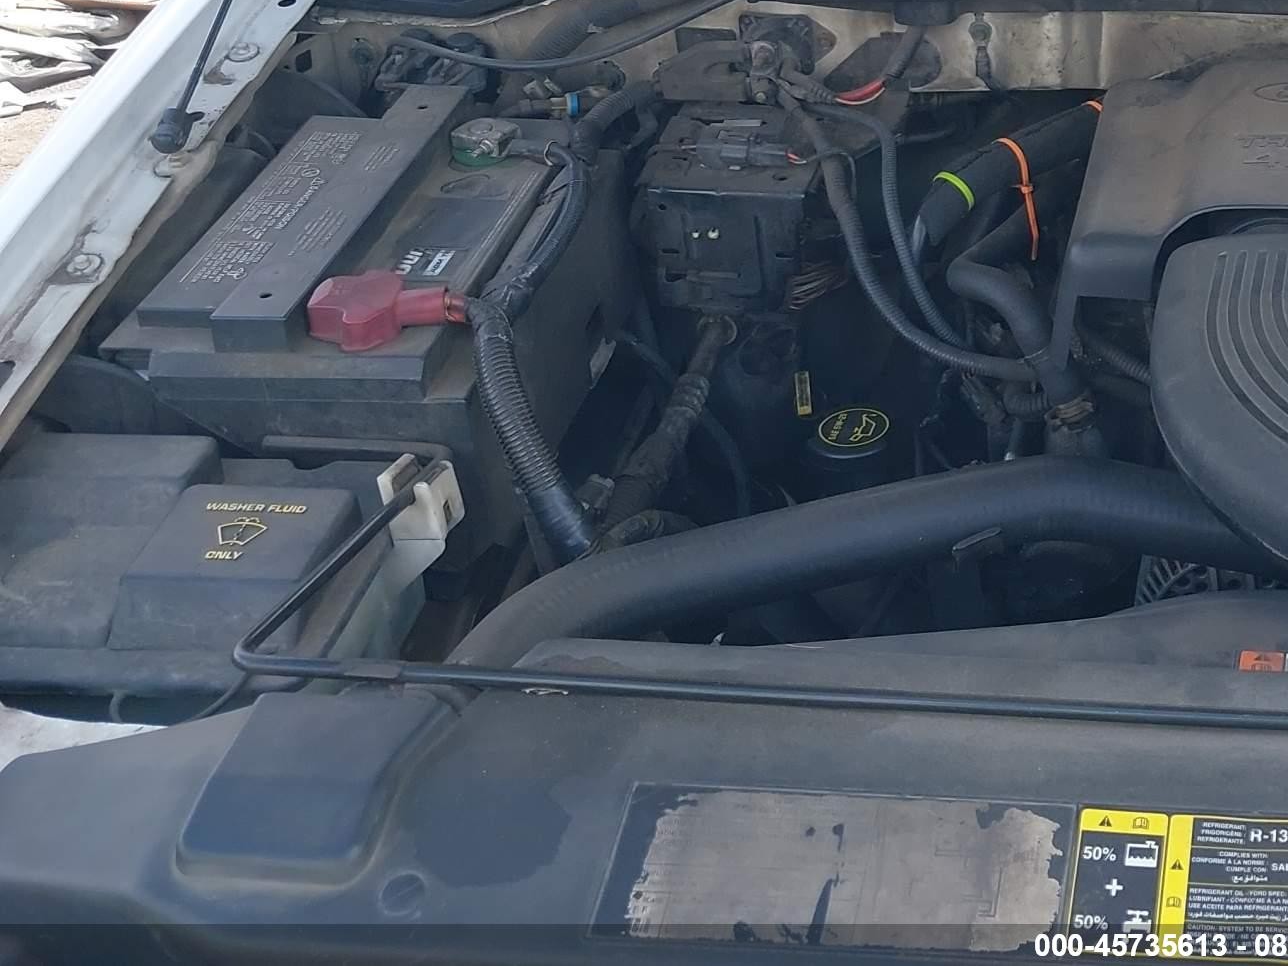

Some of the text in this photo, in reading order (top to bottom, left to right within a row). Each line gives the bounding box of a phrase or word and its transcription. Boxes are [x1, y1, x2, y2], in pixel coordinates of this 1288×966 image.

[206, 502, 308, 514] WASHER FLUID
[205, 550, 243, 560] ONLY
[1082, 845, 1117, 862] 50%
[1219, 850, 1251, 859] COMPLIES
[1191, 856, 1227, 865] CONFORME
[1233, 858, 1242, 866] LA
[1225, 866, 1252, 874] CUMPLE
[1188, 887, 1233, 897] REFRIGERANT
[1202, 903, 1225, 911] ACEITE
[1073, 913, 1109, 931] 50%
